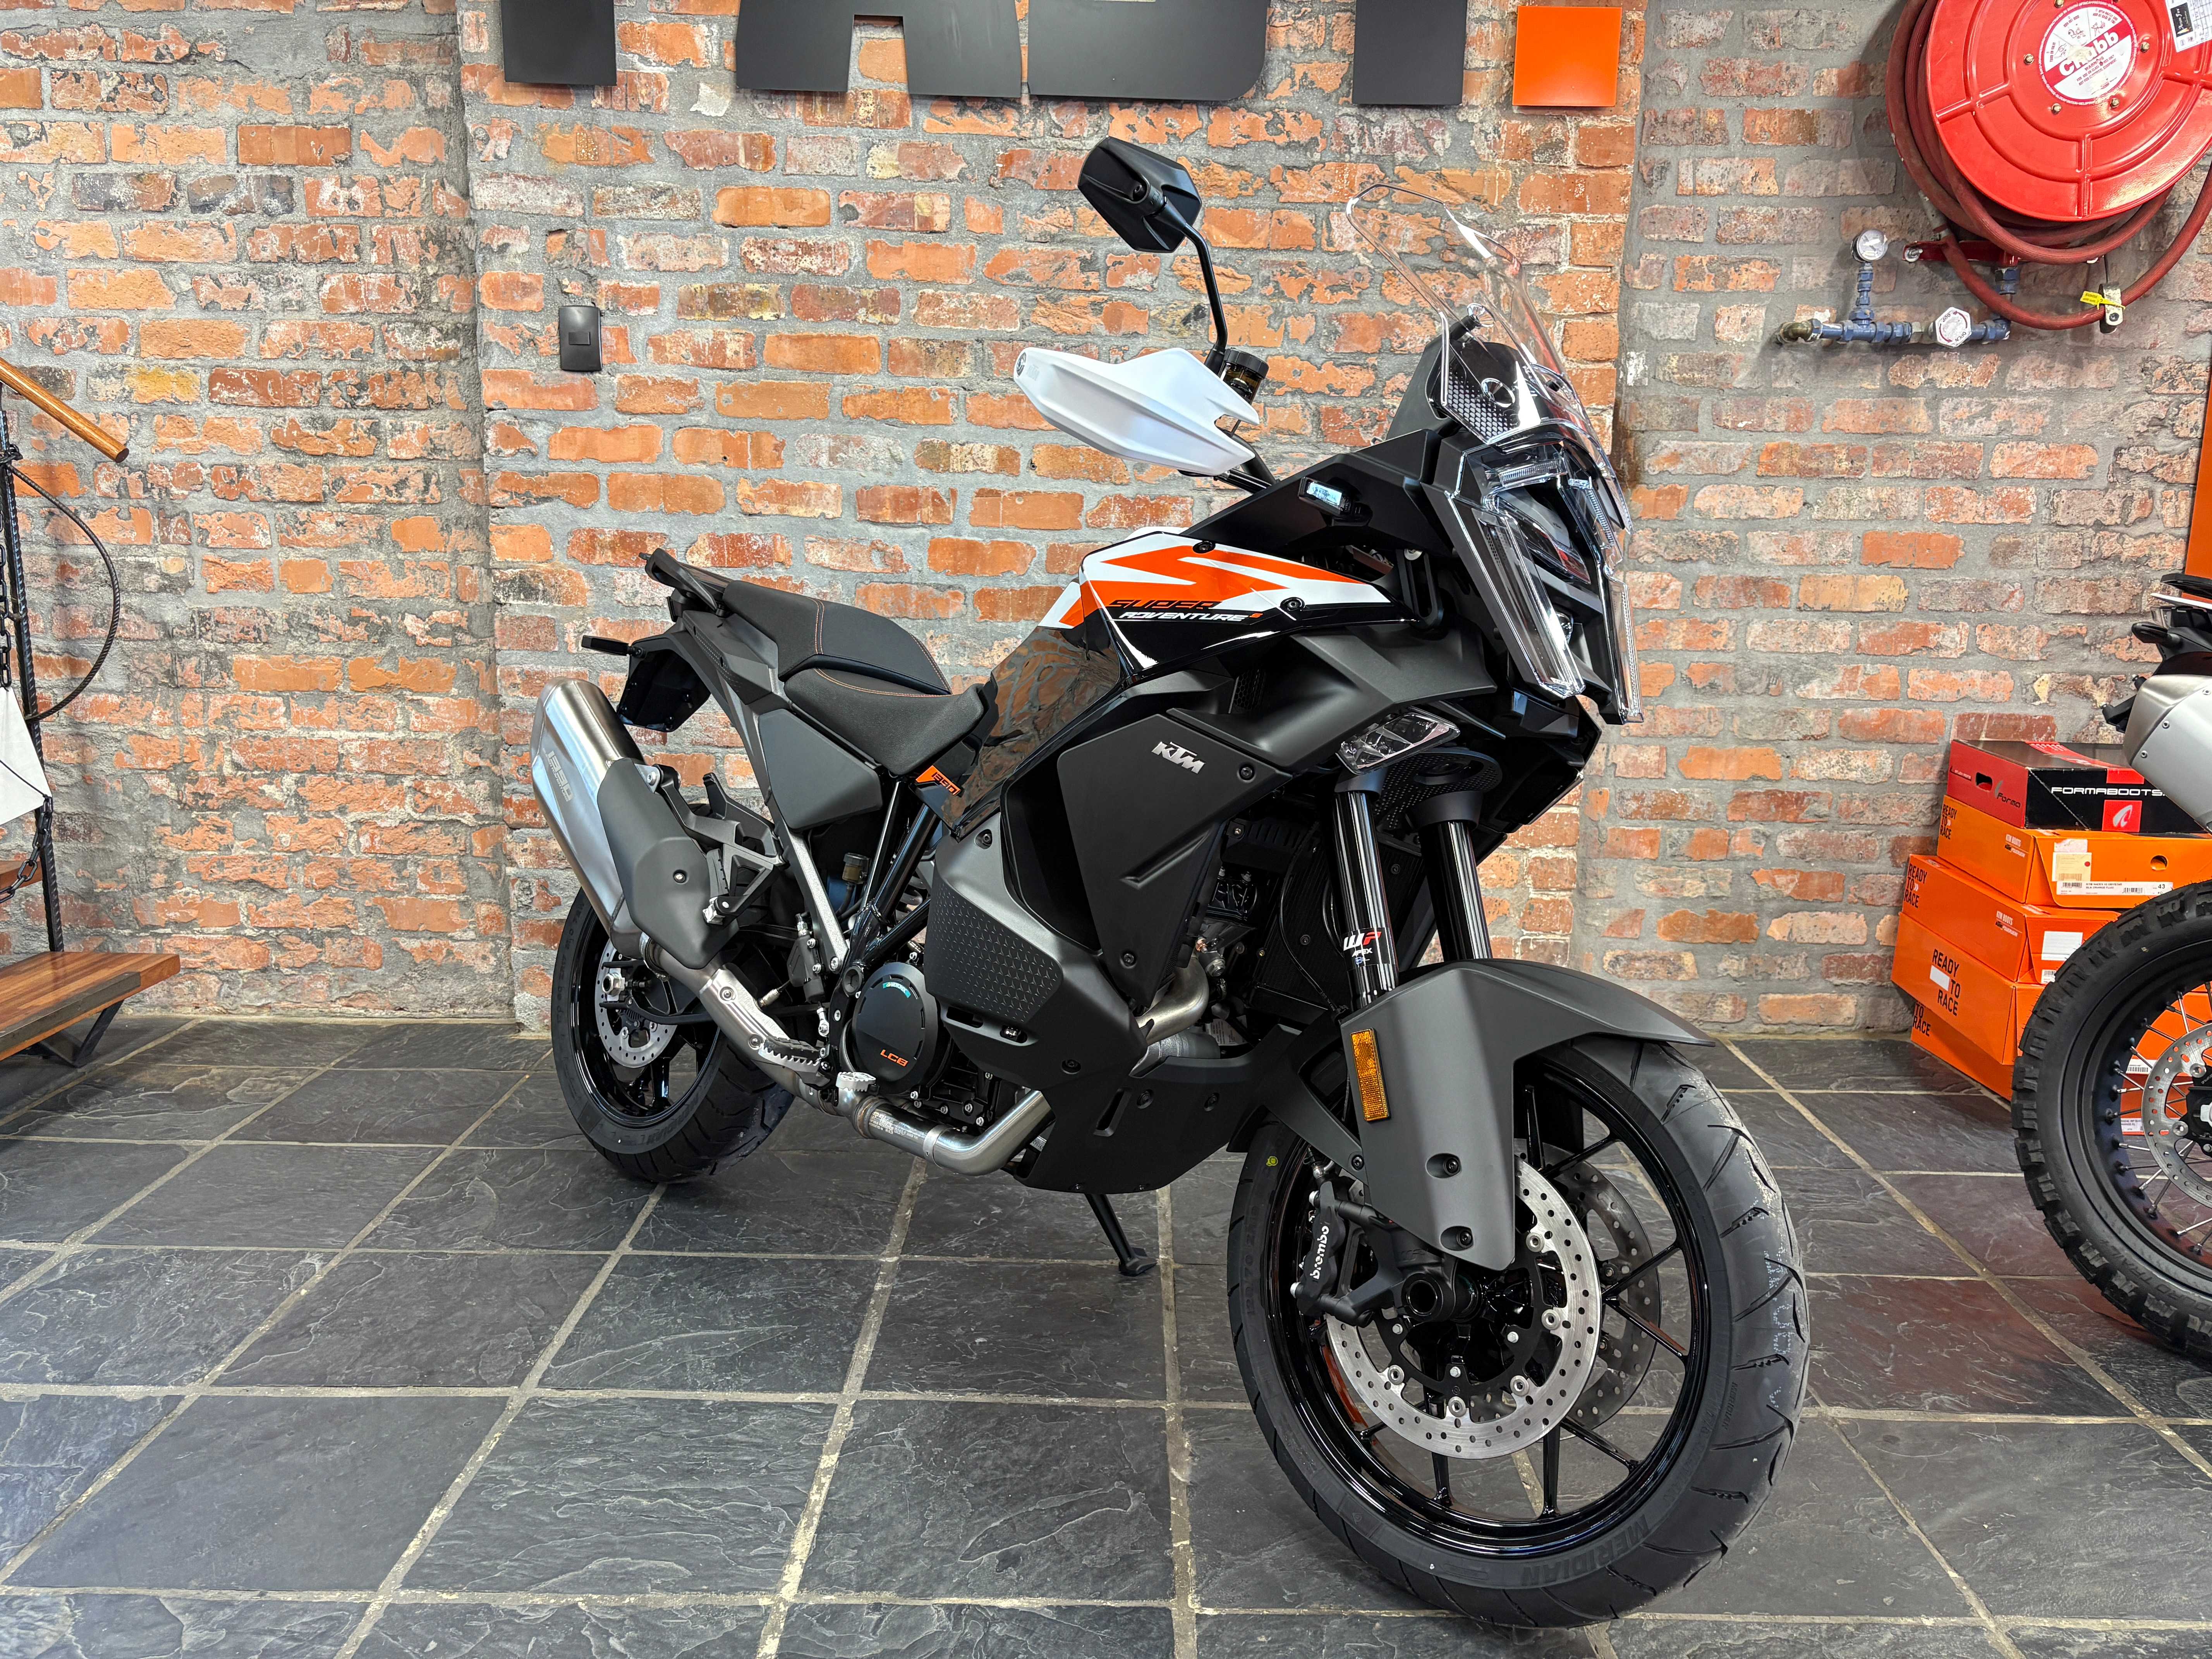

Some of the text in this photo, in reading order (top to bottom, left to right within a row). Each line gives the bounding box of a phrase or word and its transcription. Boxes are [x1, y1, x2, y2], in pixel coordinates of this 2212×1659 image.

[1105, 599, 1223, 610] SUPER
[1119, 611, 1249, 622] ADVENTURE
[1151, 741, 1205, 774] KTM
[1942, 804, 1957, 820] READY
[1942, 815, 1948, 826] TO
[1939, 825, 1952, 840] RACE
[1908, 863, 1927, 884] READY
[1906, 877, 1914, 891] TO
[1904, 889, 1920, 908] RACE
[1352, 948, 1373, 957] APEX
[1932, 948, 1960, 978] READY
[1950, 979, 1961, 999] TO
[1915, 1003, 1924, 1019] TO
[1937, 989, 1959, 1017] RACE
[1912, 1015, 1931, 1037] RACE
[1310, 1225, 1329, 1280] brembo
[1521, 1514, 1650, 1587] MERIDIAN
